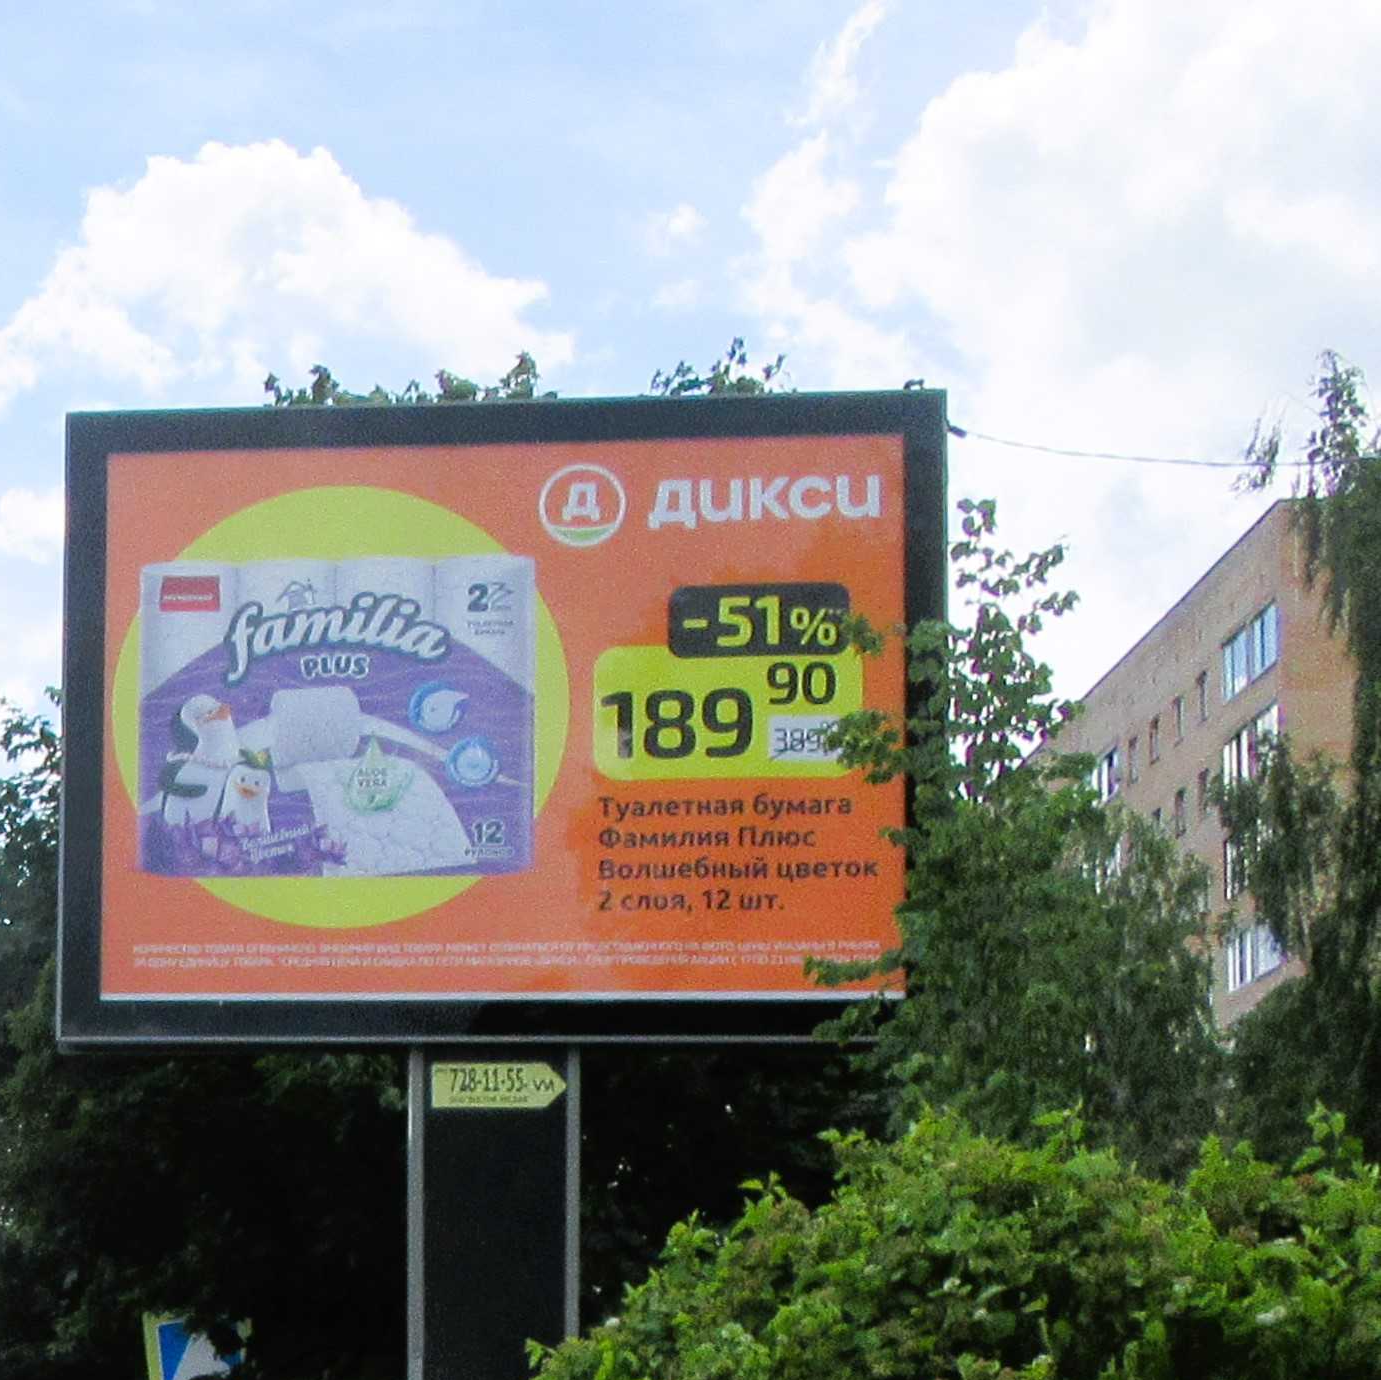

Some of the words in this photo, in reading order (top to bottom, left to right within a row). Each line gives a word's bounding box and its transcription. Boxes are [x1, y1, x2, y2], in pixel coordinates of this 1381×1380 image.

[467, 583, 488, 612] 2
[682, 595, 837, 649] -51%
[225, 592, 450, 685] familia
[301, 654, 369, 679] PLUS
[600, 688, 754, 760] 189
[766, 661, 837, 706] 90
[598, 797, 744, 822] Туалетная
[753, 793, 852, 820] бумага
[473, 820, 503, 844] 12
[599, 827, 729, 848] Фамилия
[739, 826, 816, 848] Плюс
[599, 855, 768, 880] Волшебный
[777, 860, 879, 882] цветок
[599, 892, 612, 911] 2
[621, 891, 693, 914] слоя,
[703, 889, 730, 910] 12
[739, 891, 785, 911] шт.
